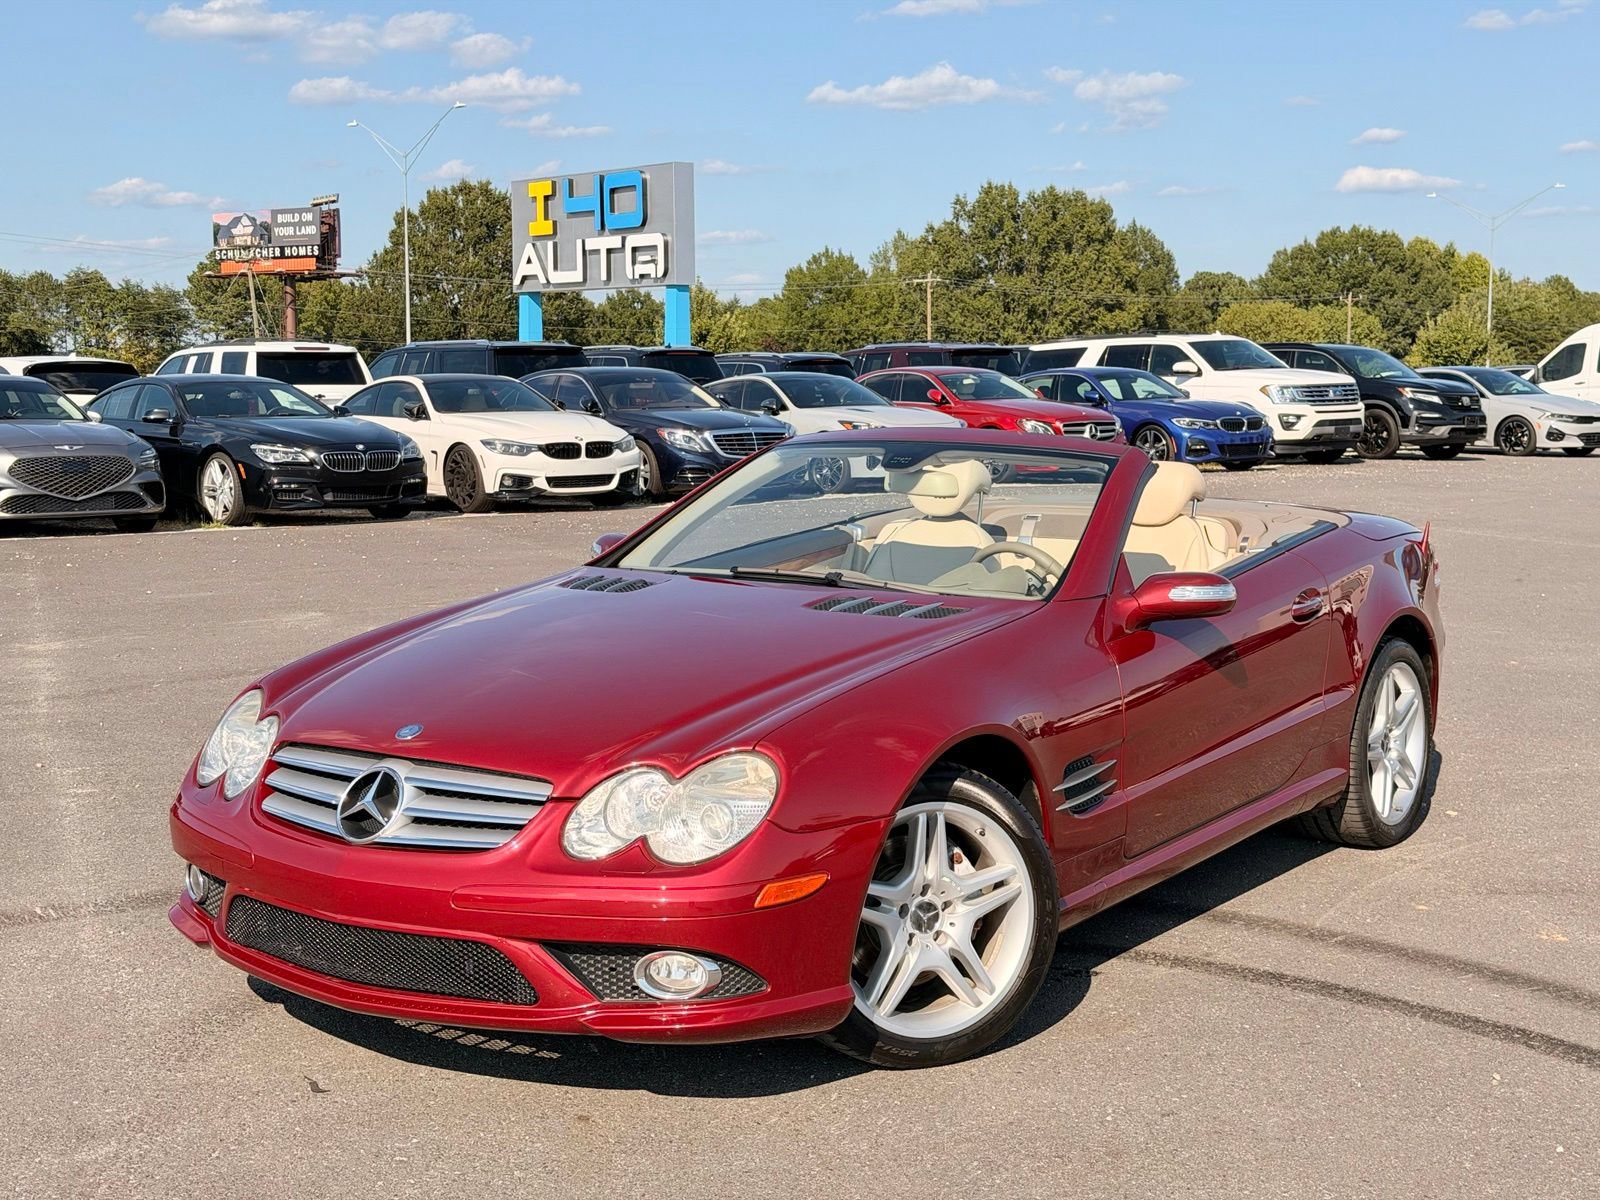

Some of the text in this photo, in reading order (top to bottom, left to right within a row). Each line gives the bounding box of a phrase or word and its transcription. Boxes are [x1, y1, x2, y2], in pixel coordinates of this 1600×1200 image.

[277, 212, 313, 223] BUILD ON
[273, 225, 317, 236] YOUR LAND
[284, 245, 319, 257] HOMES
[513, 232, 665, 286] AUTO
